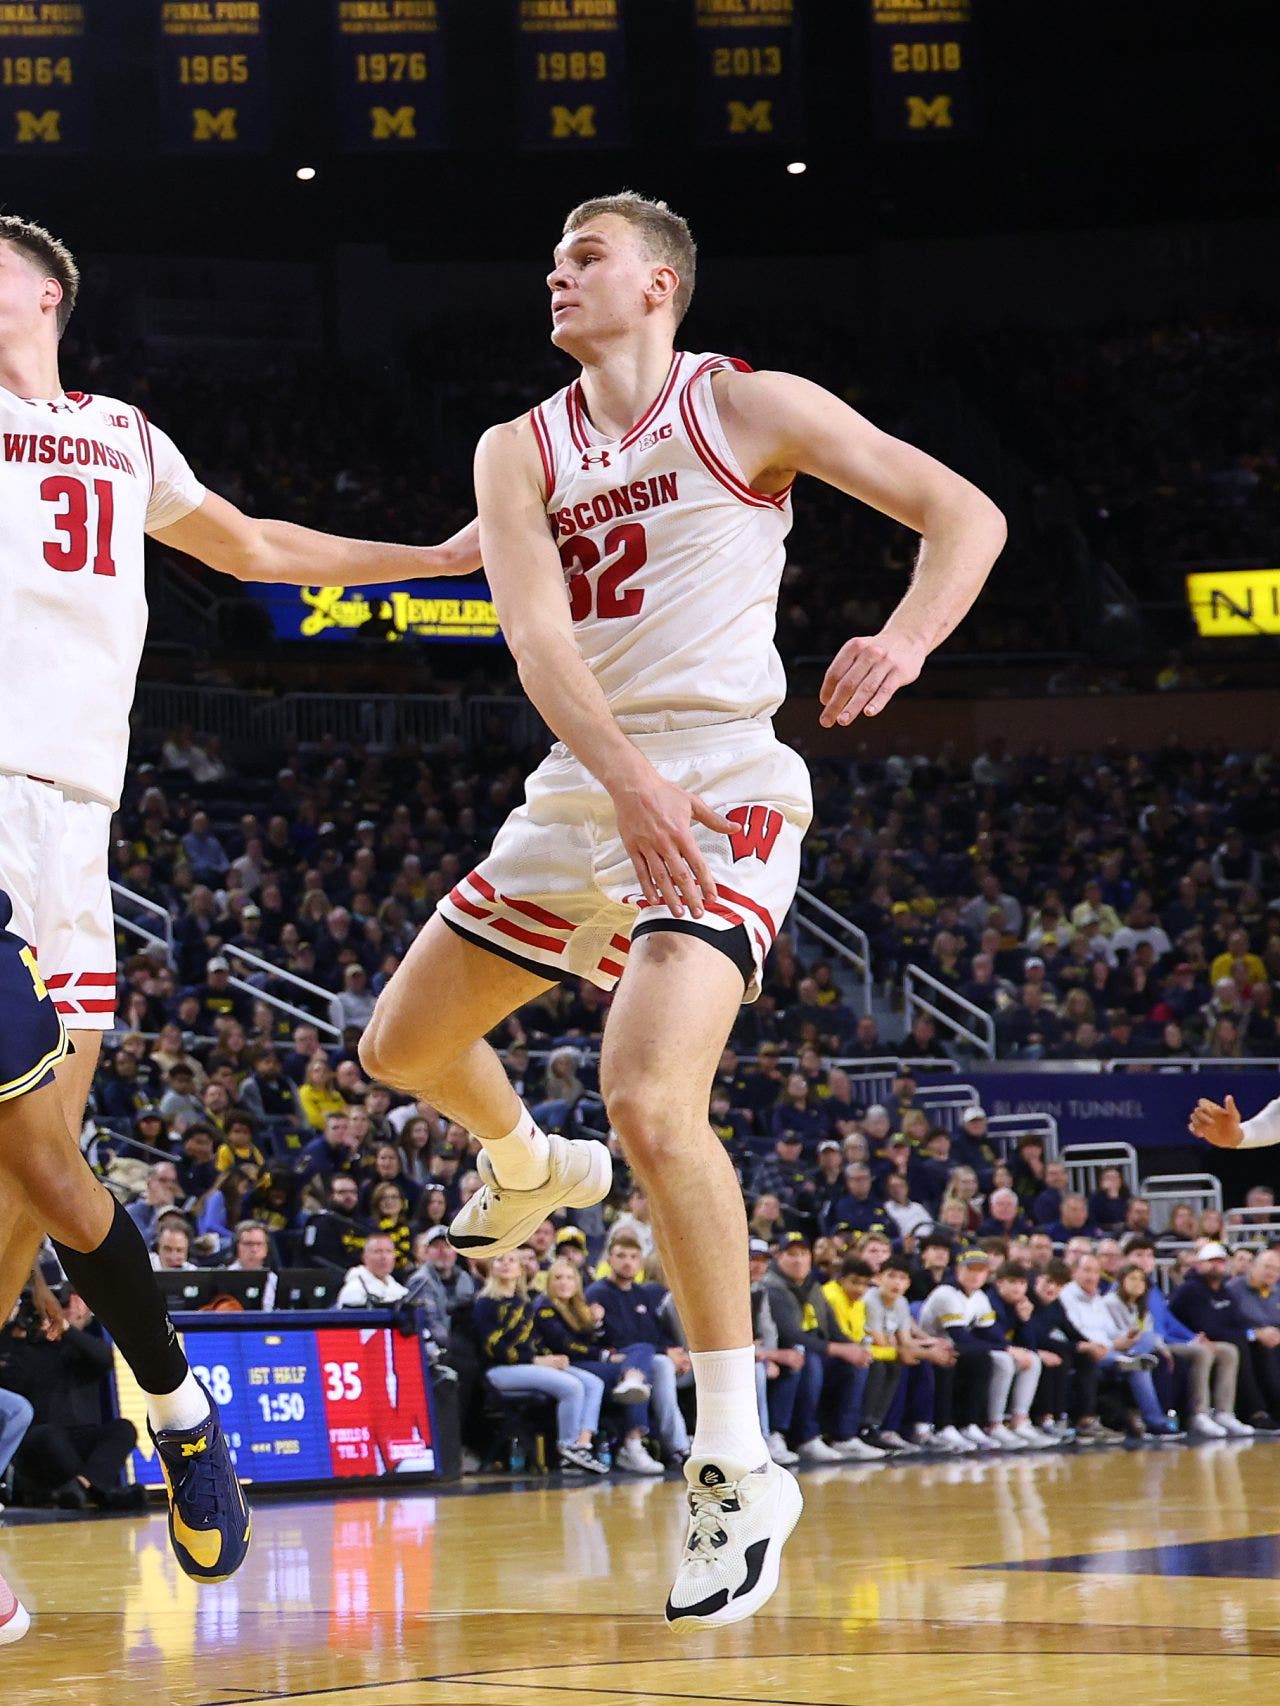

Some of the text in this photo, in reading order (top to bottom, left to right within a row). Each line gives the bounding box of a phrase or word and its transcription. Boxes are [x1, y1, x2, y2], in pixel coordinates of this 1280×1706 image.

[3, 57, 72, 85] 1964
[180, 55, 248, 84] 1965
[356, 53, 427, 82] 1976
[537, 51, 606, 80] 1989
[714, 47, 782, 76] 2013
[891, 42, 961, 72] 2018
[17, 110, 61, 142] M
[193, 108, 237, 140] M
[372, 106, 416, 139] M
[551, 105, 595, 137] M
[728, 101, 772, 132] M
[907, 96, 951, 128] M
[3, 433, 137, 479] WISCONSIN
[548, 471, 680, 541] ISCONSIN
[40, 475, 116, 577] 31
[725, 804, 784, 865] W
[323, 1361, 363, 1401] 35
[257, 1392, 306, 1422] 1:50
[181, 1435, 208, 1456] M
